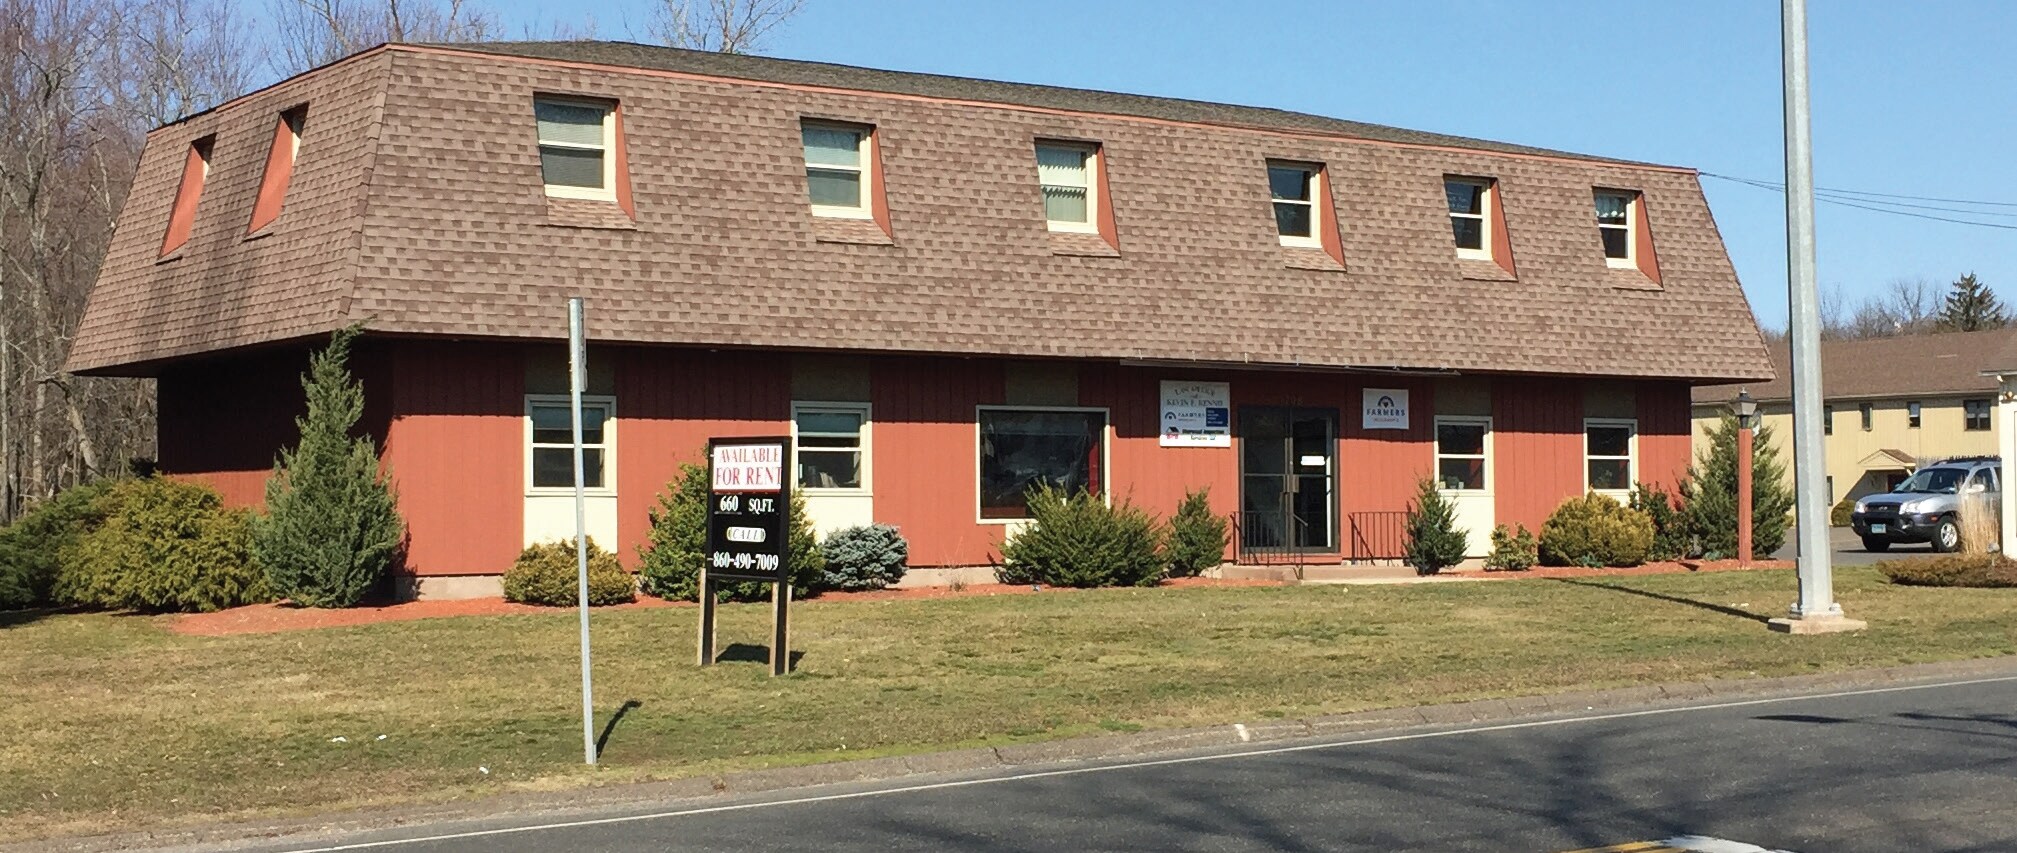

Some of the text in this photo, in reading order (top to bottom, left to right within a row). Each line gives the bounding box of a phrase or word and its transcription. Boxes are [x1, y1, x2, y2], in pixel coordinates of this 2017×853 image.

[1366, 408, 1406, 417] FARMERS
[721, 447, 780, 463] AVAILABLE
[715, 466, 782, 485] FOR RENT
[720, 494, 739, 512] 660
[732, 528, 759, 540] CALL
[713, 551, 779, 570] 860-490-7009
